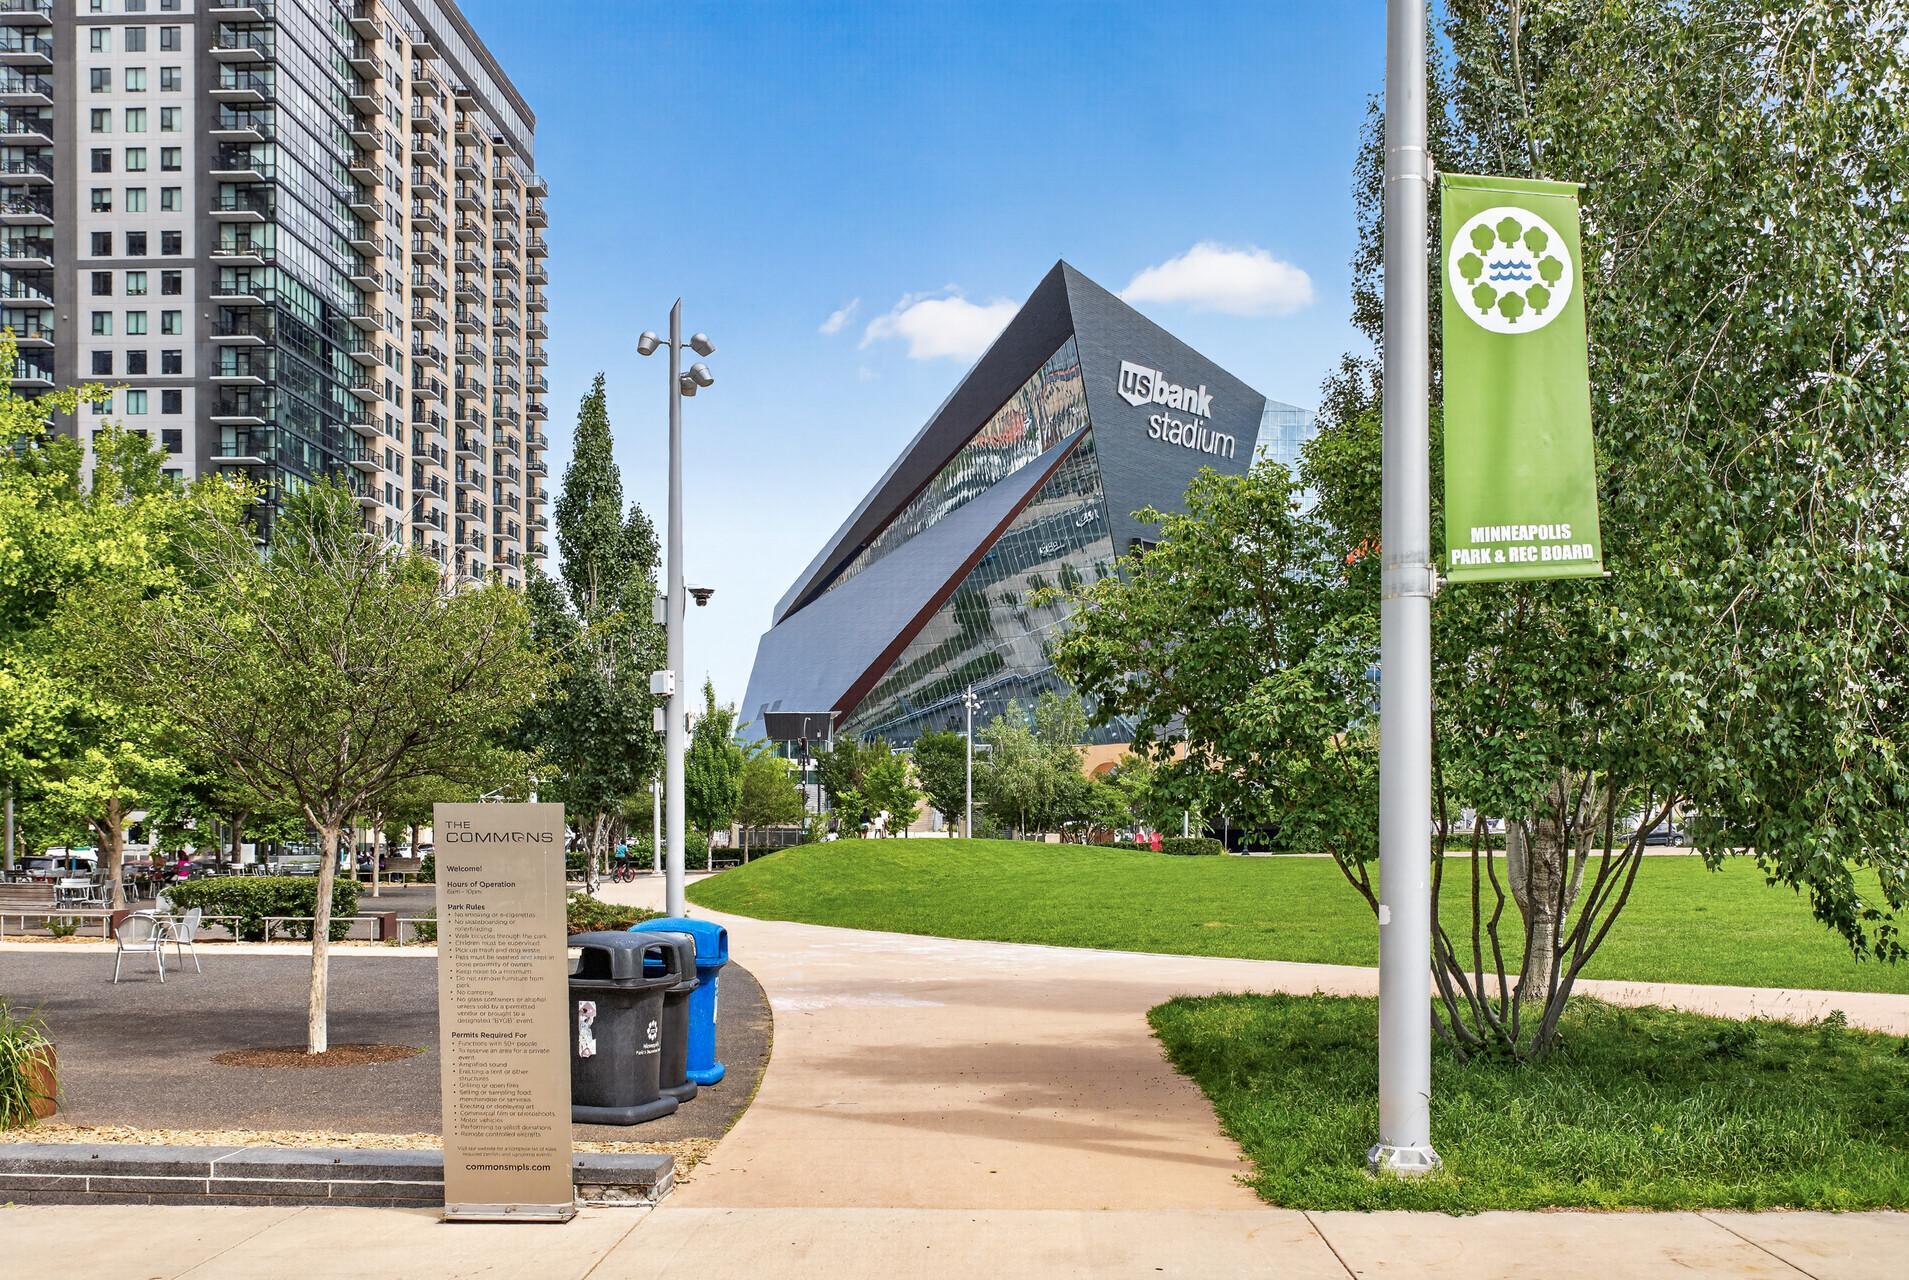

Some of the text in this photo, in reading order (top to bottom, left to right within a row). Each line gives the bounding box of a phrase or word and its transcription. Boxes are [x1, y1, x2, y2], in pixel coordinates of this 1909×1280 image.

[1148, 411, 1236, 459] stadium
[1470, 523, 1572, 543] MINNEAPOLIS
[1451, 543, 1594, 565] PARK & REC BOARD
[446, 832, 553, 843] COMMONS
